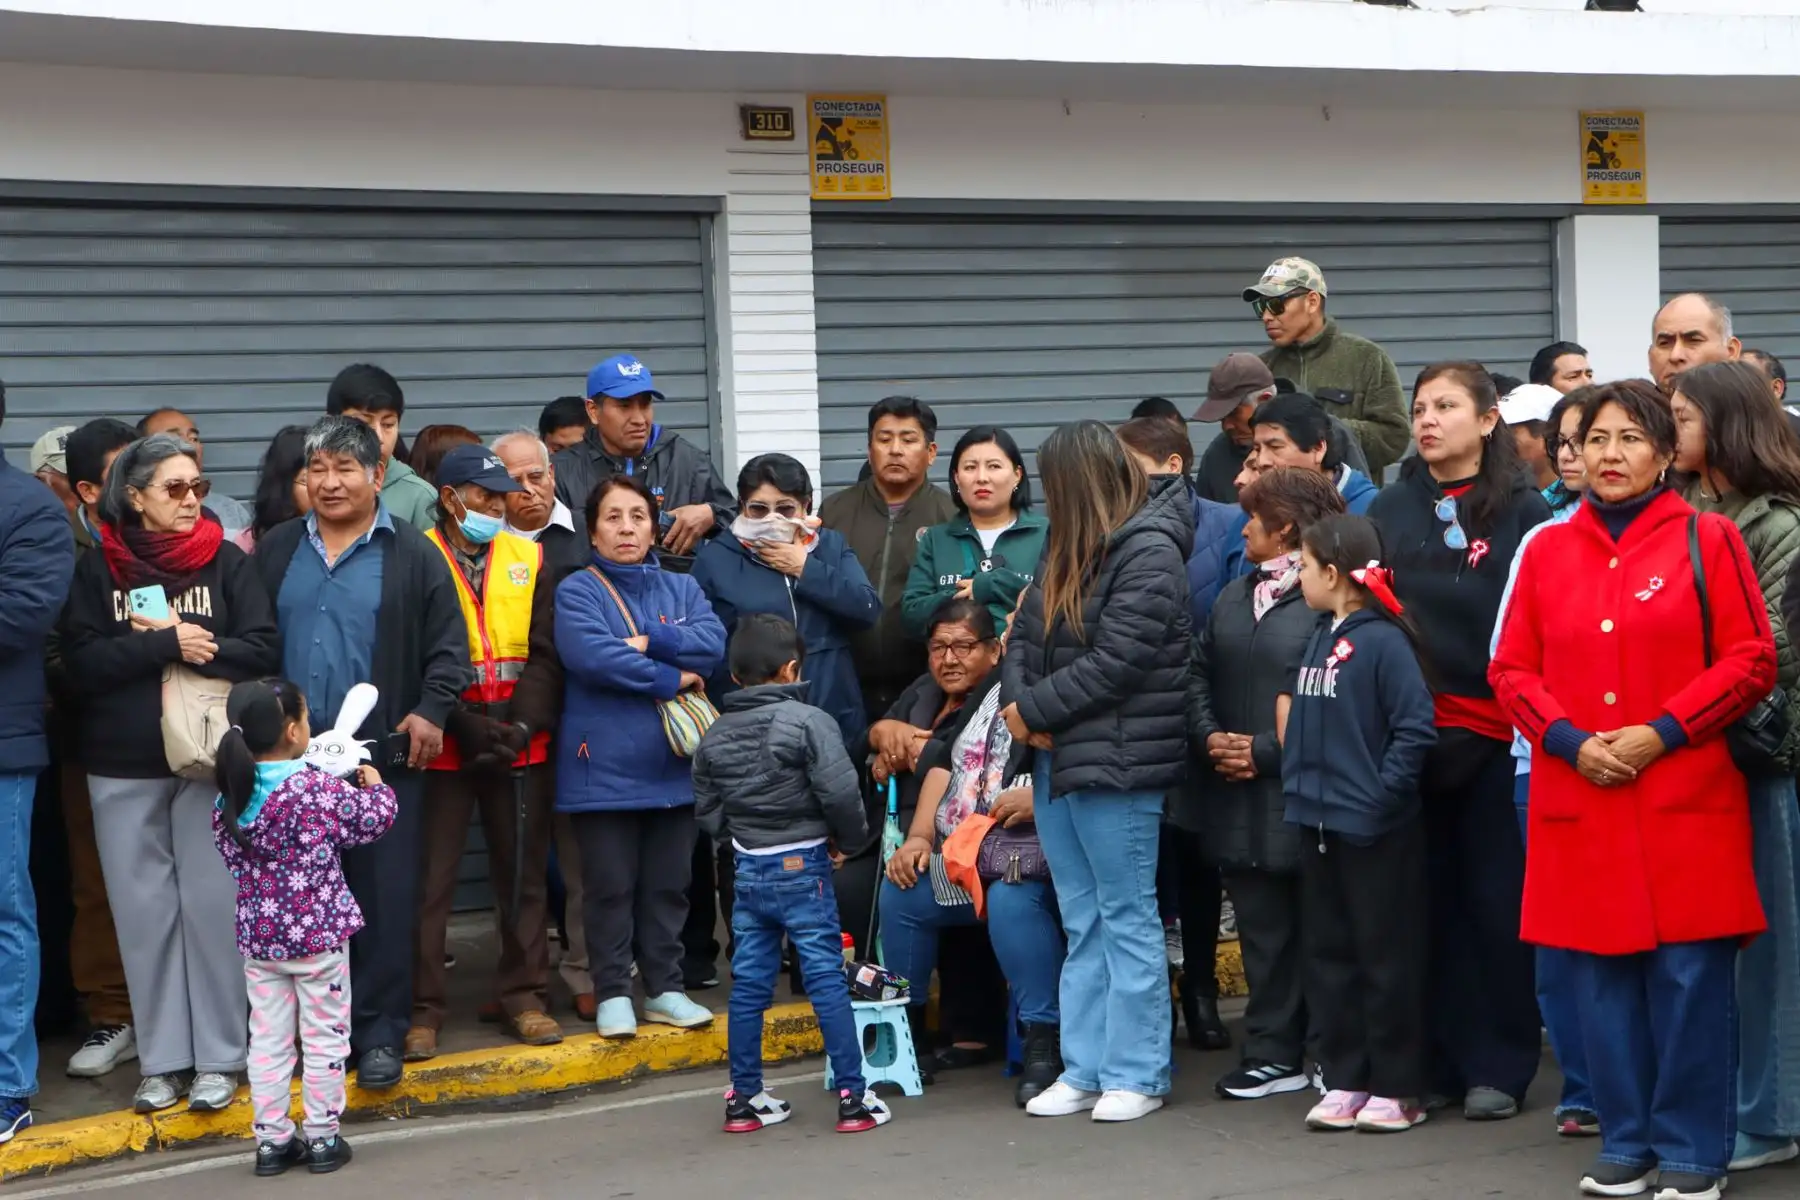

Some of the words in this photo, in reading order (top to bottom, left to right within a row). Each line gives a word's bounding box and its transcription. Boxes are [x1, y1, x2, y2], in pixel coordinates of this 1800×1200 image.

[814, 101, 881, 111] CONECTADA
[756, 114, 783, 130] 310
[1586, 116, 1640, 126] CONECTADA
[816, 163, 885, 174] PROSEGUR
[1587, 171, 1641, 181] PROSEGUR
[114, 586, 213, 622] CARNIA
